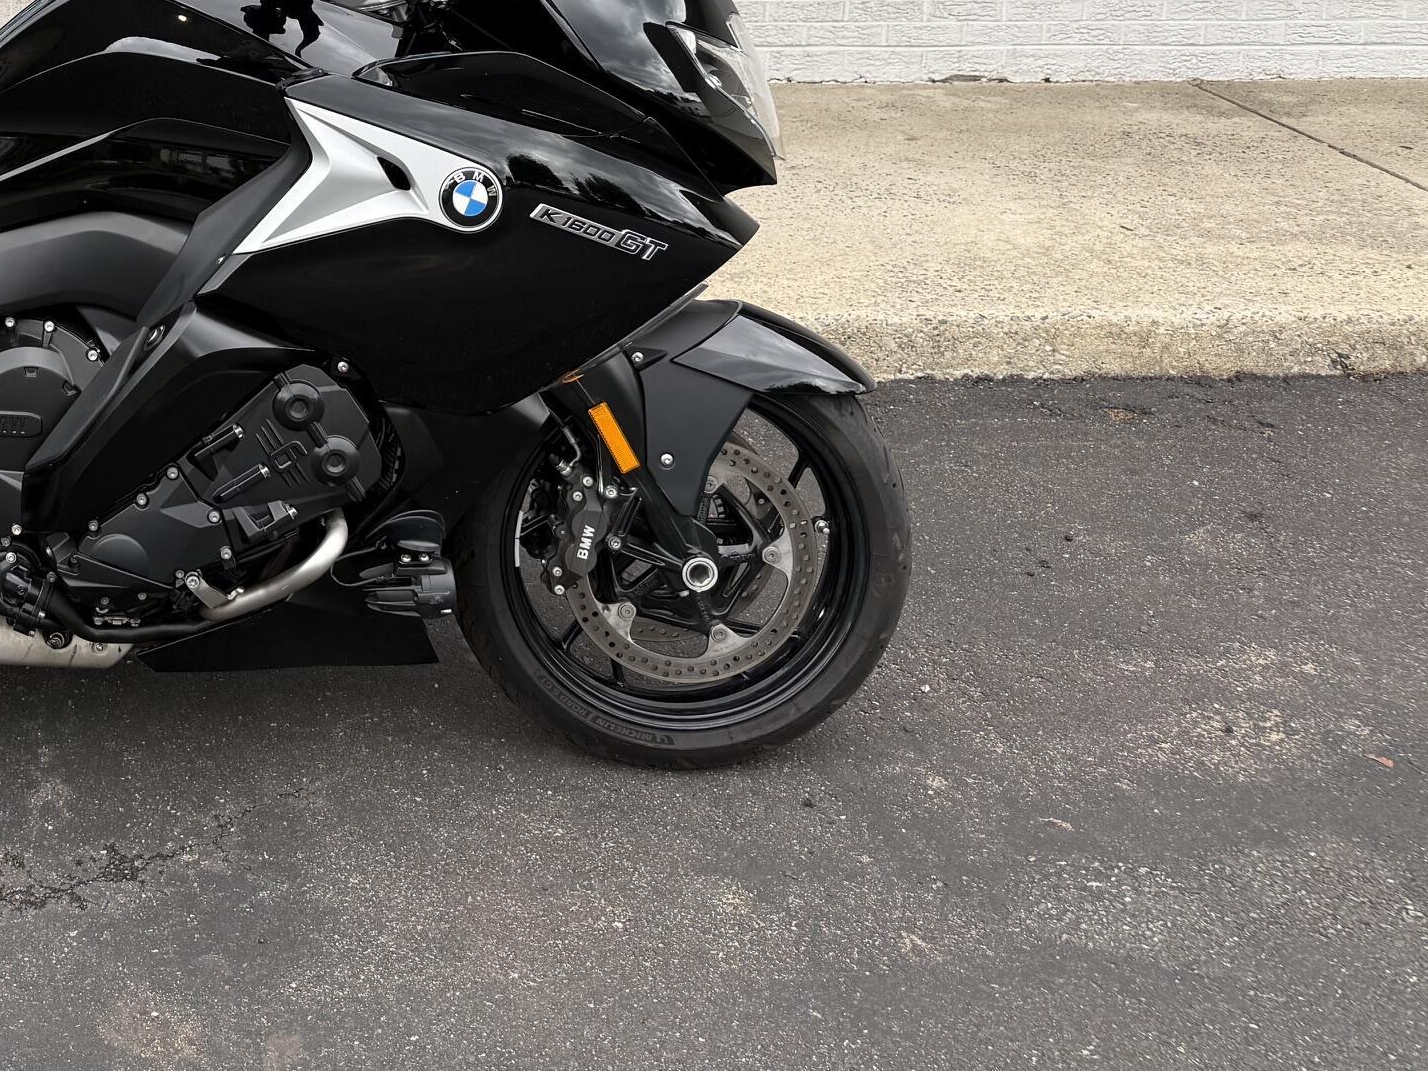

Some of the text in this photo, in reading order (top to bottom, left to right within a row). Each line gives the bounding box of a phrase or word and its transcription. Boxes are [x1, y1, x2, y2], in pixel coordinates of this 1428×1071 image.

[453, 170, 497, 197] BMW
[562, 216, 616, 243] 1600
[614, 229, 668, 261] GT
[576, 524, 595, 560] BMW
[595, 717, 653, 741] MICHELIN
